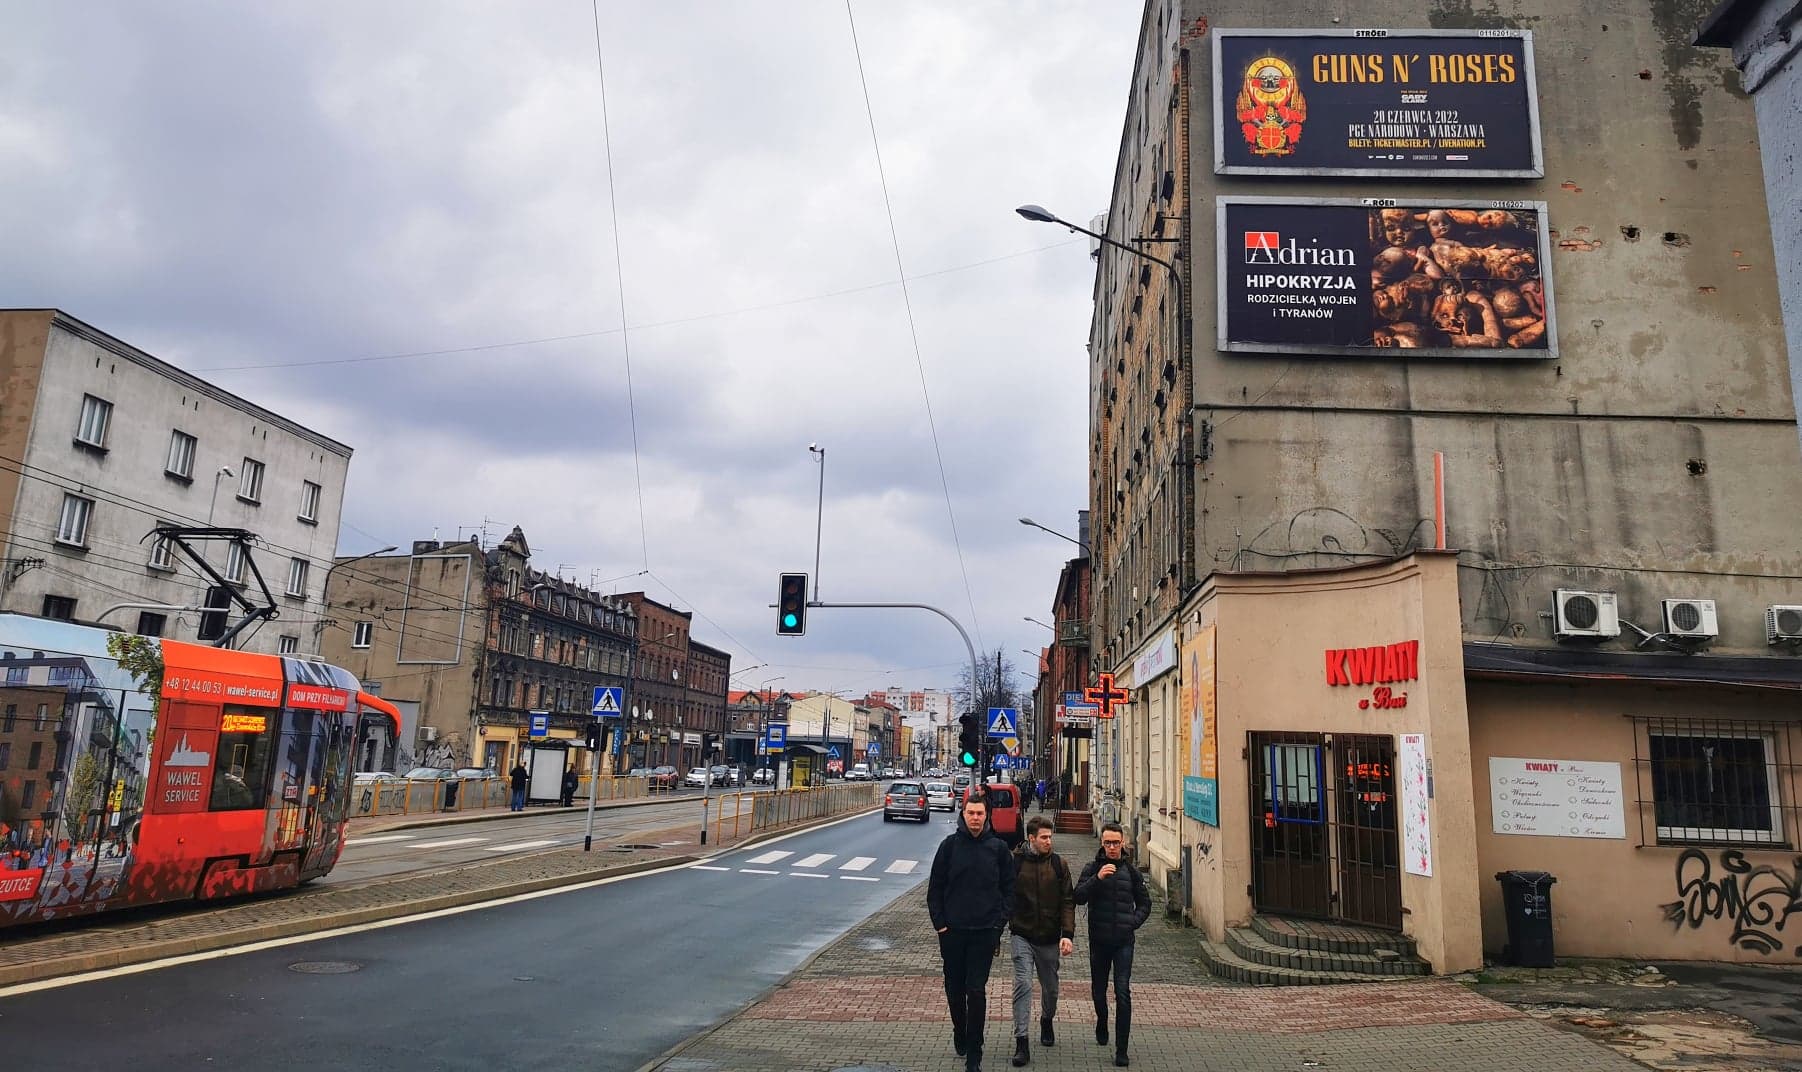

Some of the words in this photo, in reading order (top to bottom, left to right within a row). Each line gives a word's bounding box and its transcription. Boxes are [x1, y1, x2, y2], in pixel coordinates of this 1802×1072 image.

[1312, 54, 1384, 83] GUNS
[1429, 54, 1516, 84] ROSES
[1373, 110, 1385, 124] 20
[1387, 110, 1433, 124] CZERWCA
[1435, 110, 1459, 124] 2022
[1348, 124, 1366, 138] PGE
[1368, 124, 1420, 138] NARODOWY
[1428, 124, 1485, 138] WARSZAWA
[1348, 139, 1371, 148] BILETY:
[1373, 139, 1431, 148] TICKETMASTER.PL
[1438, 139, 1486, 148] LIVENATION.PL
[1245, 231, 1356, 266] Adrian
[1246, 274, 1357, 290] HIPOKRYZJA
[1247, 294, 1317, 306] RODZICIELKĄ
[1319, 295, 1357, 305] WOJEN
[1279, 307, 1333, 319] TYRANÓW
[1325, 640, 1419, 687] KWIATY
[166, 677, 180, 690] +48
[182, 679, 190, 691] 12
[191, 680, 201, 691] 44
[227, 685, 279, 701] wawel-service.pl
[306, 691, 322, 704] PRZY
[222, 714, 232, 731] 20
[1525, 762, 1559, 772] KWIATY
[167, 771, 202, 786] WAWEL
[165, 789, 200, 802] SERVICE
